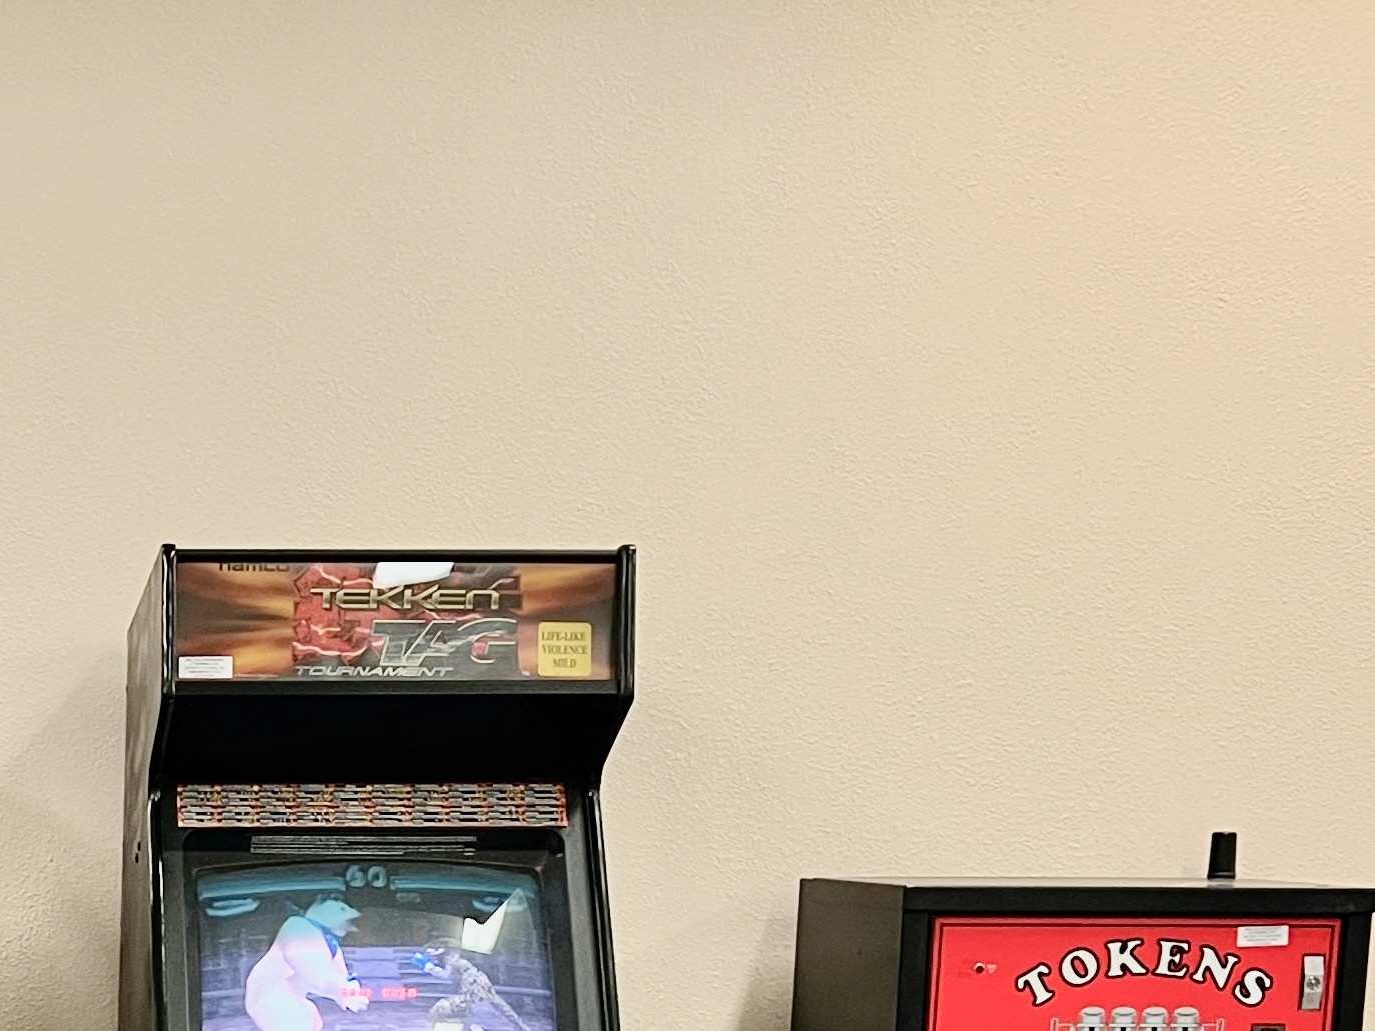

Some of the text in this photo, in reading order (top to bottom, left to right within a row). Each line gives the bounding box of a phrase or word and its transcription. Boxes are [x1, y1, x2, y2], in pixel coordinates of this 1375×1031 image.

[310, 584, 500, 611] TEKKEN
[541, 631, 586, 642] LIFE-LIKE
[541, 644, 588, 656] VIOLENCE
[552, 657, 577, 669] MILD
[294, 665, 454, 678] TOURNAMENT
[345, 864, 387, 889] 60
[1016, 938, 1273, 1006] TOKENS
